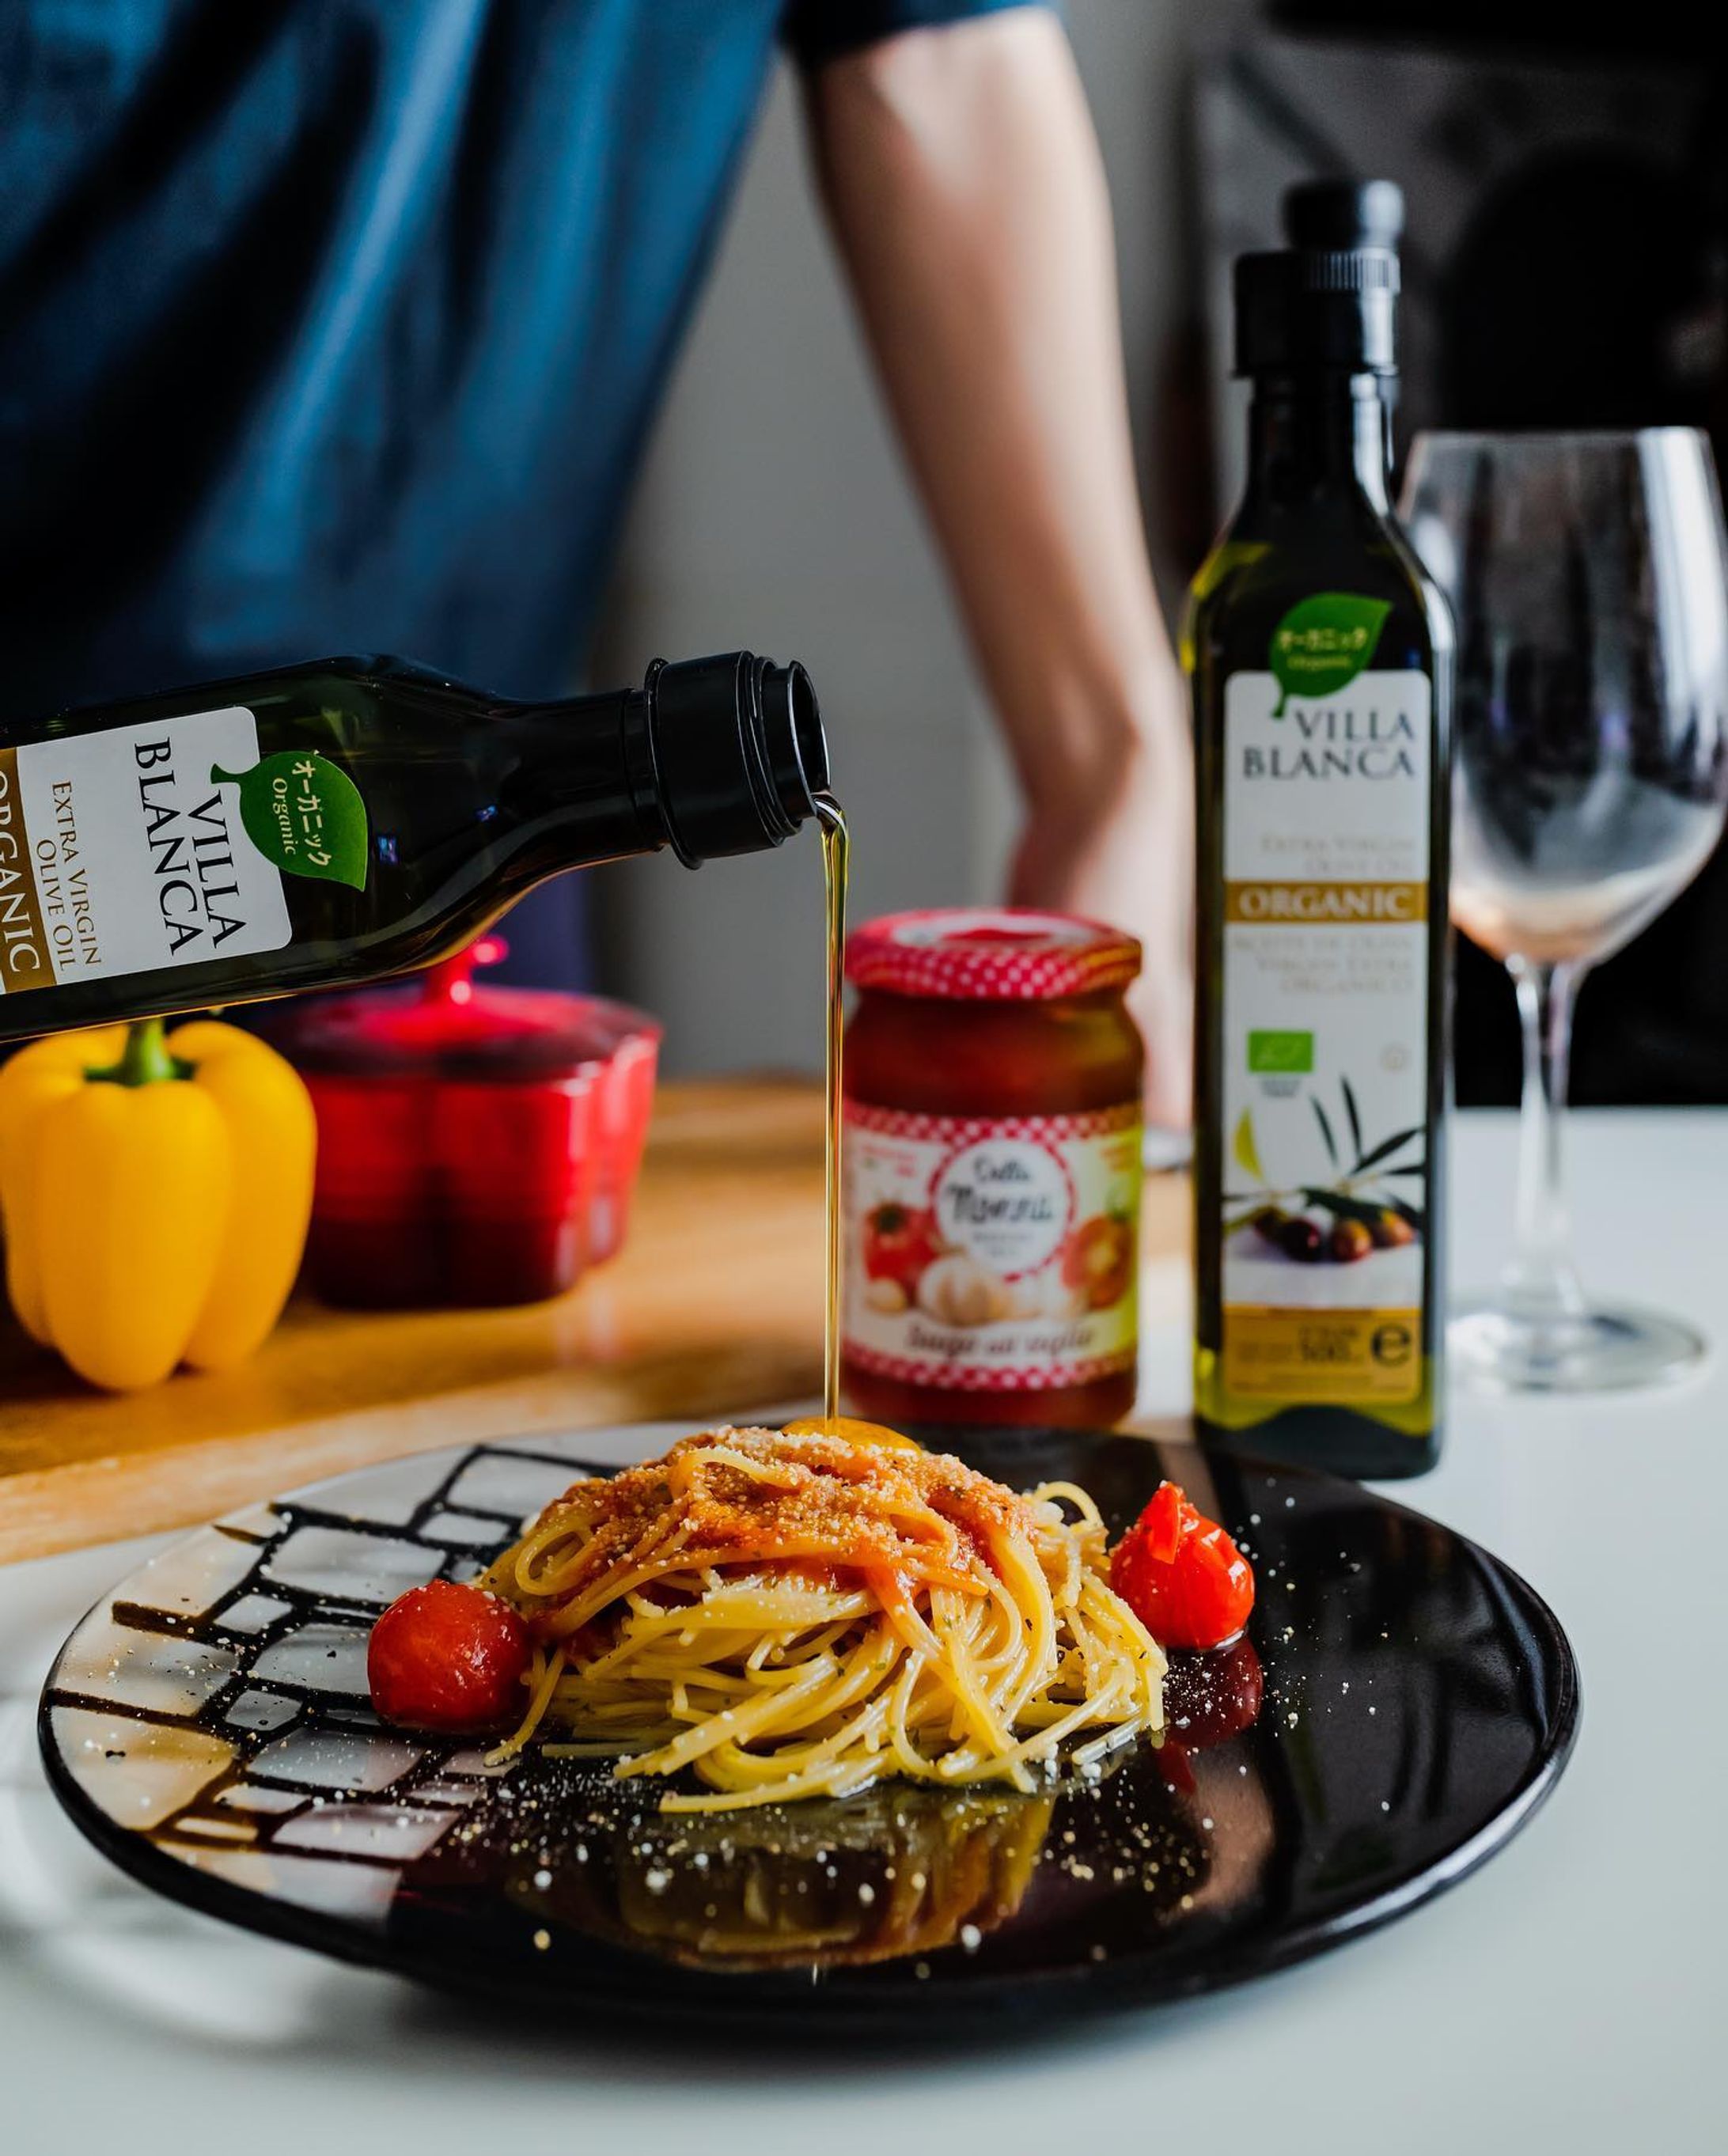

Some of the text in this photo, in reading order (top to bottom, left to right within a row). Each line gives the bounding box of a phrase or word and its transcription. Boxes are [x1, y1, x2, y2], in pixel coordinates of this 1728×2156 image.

[1242, 745, 1415, 779] BLANCA
[1294, 709, 1415, 741] VILLA
[135, 737, 204, 956] BLANCA
[271, 777, 297, 854] Organic
[292, 760, 332, 866] オーガニック
[36, 839, 77, 972] OLIVE OIL
[52, 780, 102, 965] EXTRA VIRGIN
[188, 790, 247, 948] VILLA
[1239, 886, 1412, 919] ORGANIC
